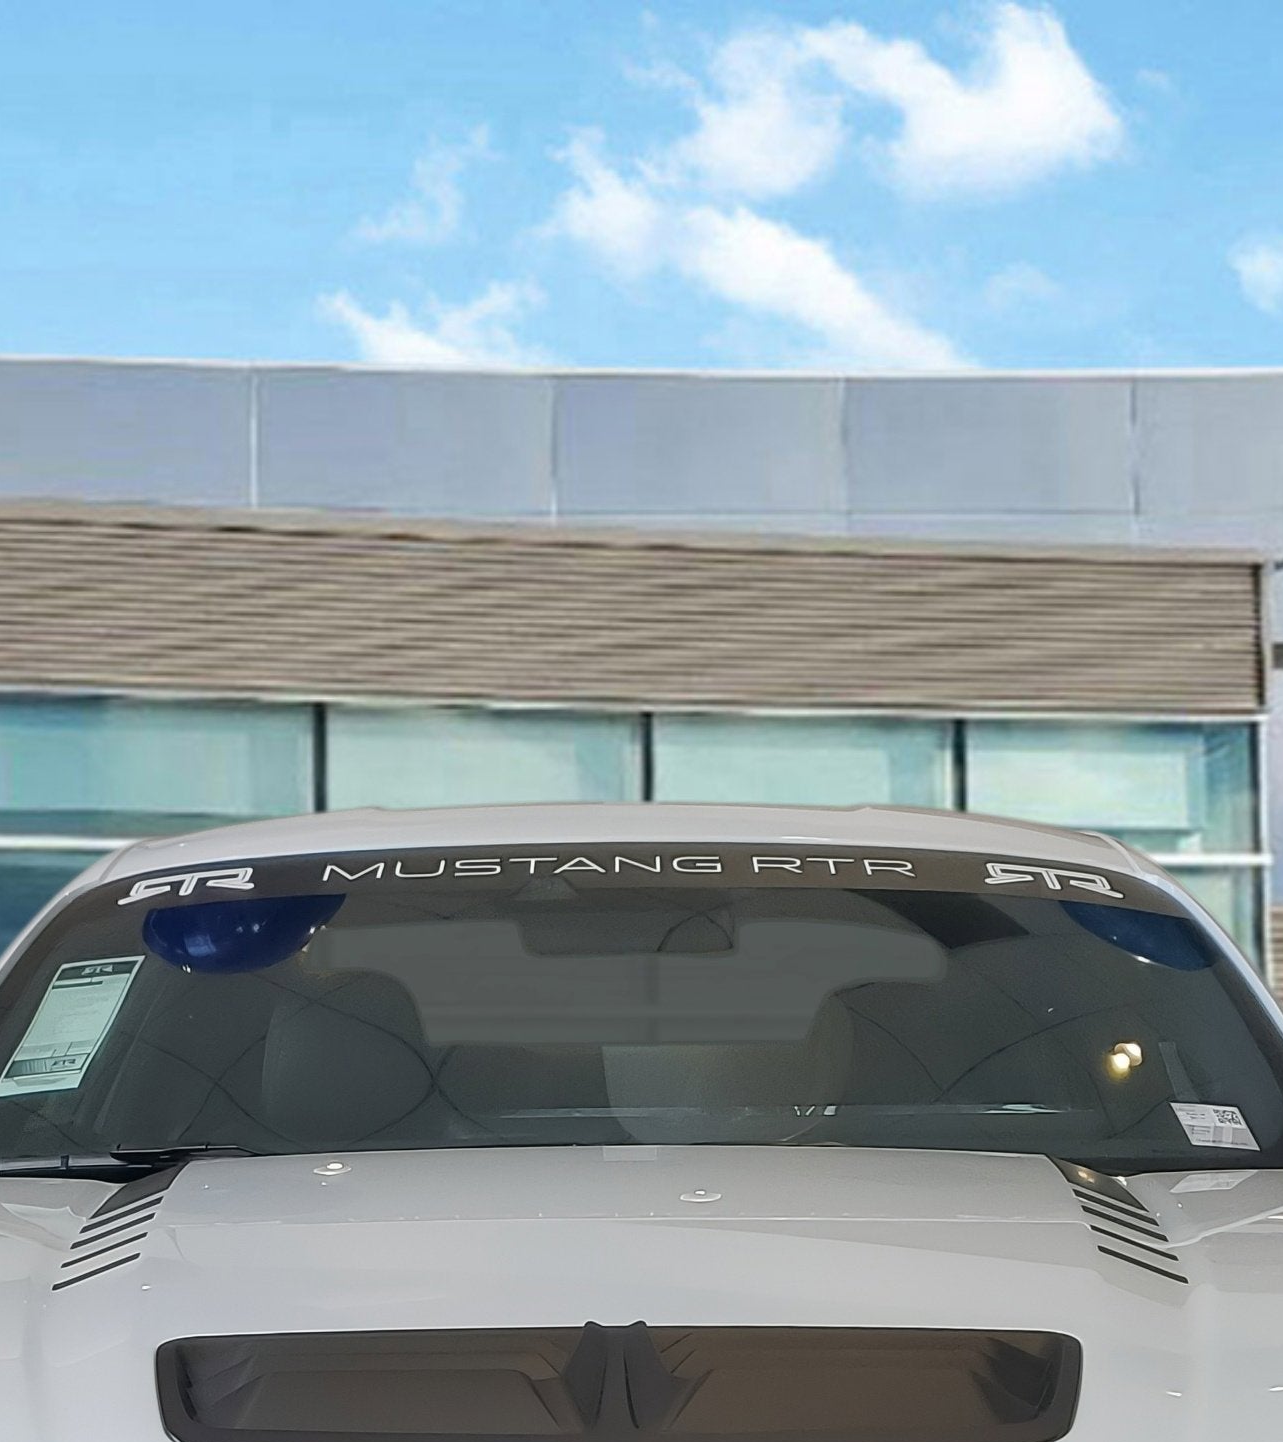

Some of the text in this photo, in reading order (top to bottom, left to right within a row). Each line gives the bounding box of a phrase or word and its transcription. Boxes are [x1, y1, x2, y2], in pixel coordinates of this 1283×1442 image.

[117, 867, 255, 906] RTR
[322, 855, 723, 882] MUSTANG
[750, 856, 917, 878] RTR
